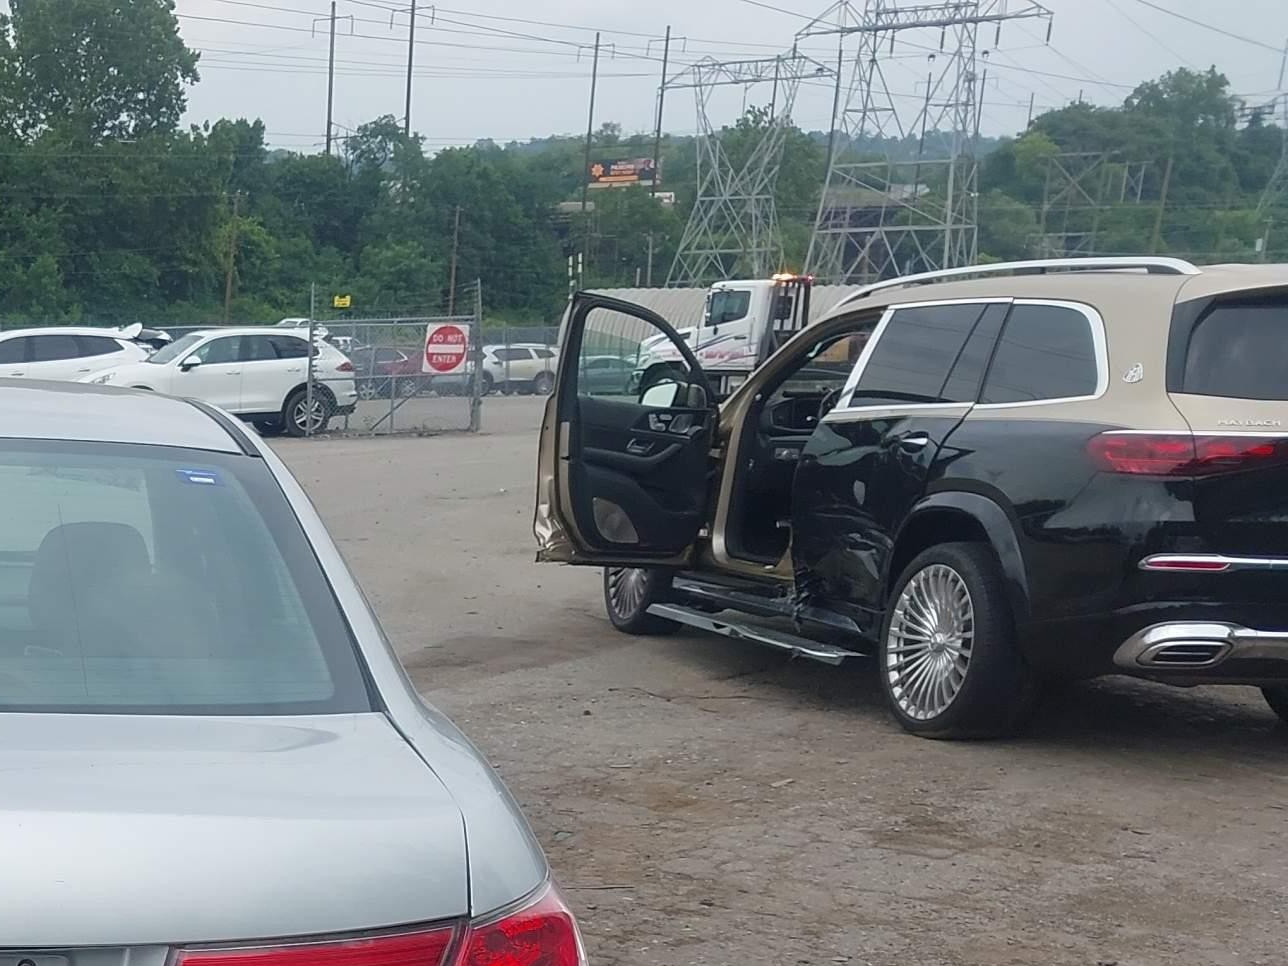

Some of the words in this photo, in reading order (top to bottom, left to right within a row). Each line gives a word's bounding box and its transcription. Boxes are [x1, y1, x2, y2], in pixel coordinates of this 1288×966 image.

[432, 334, 444, 343] DO
[447, 334, 463, 343] NOT
[431, 355, 457, 364] ENTER
